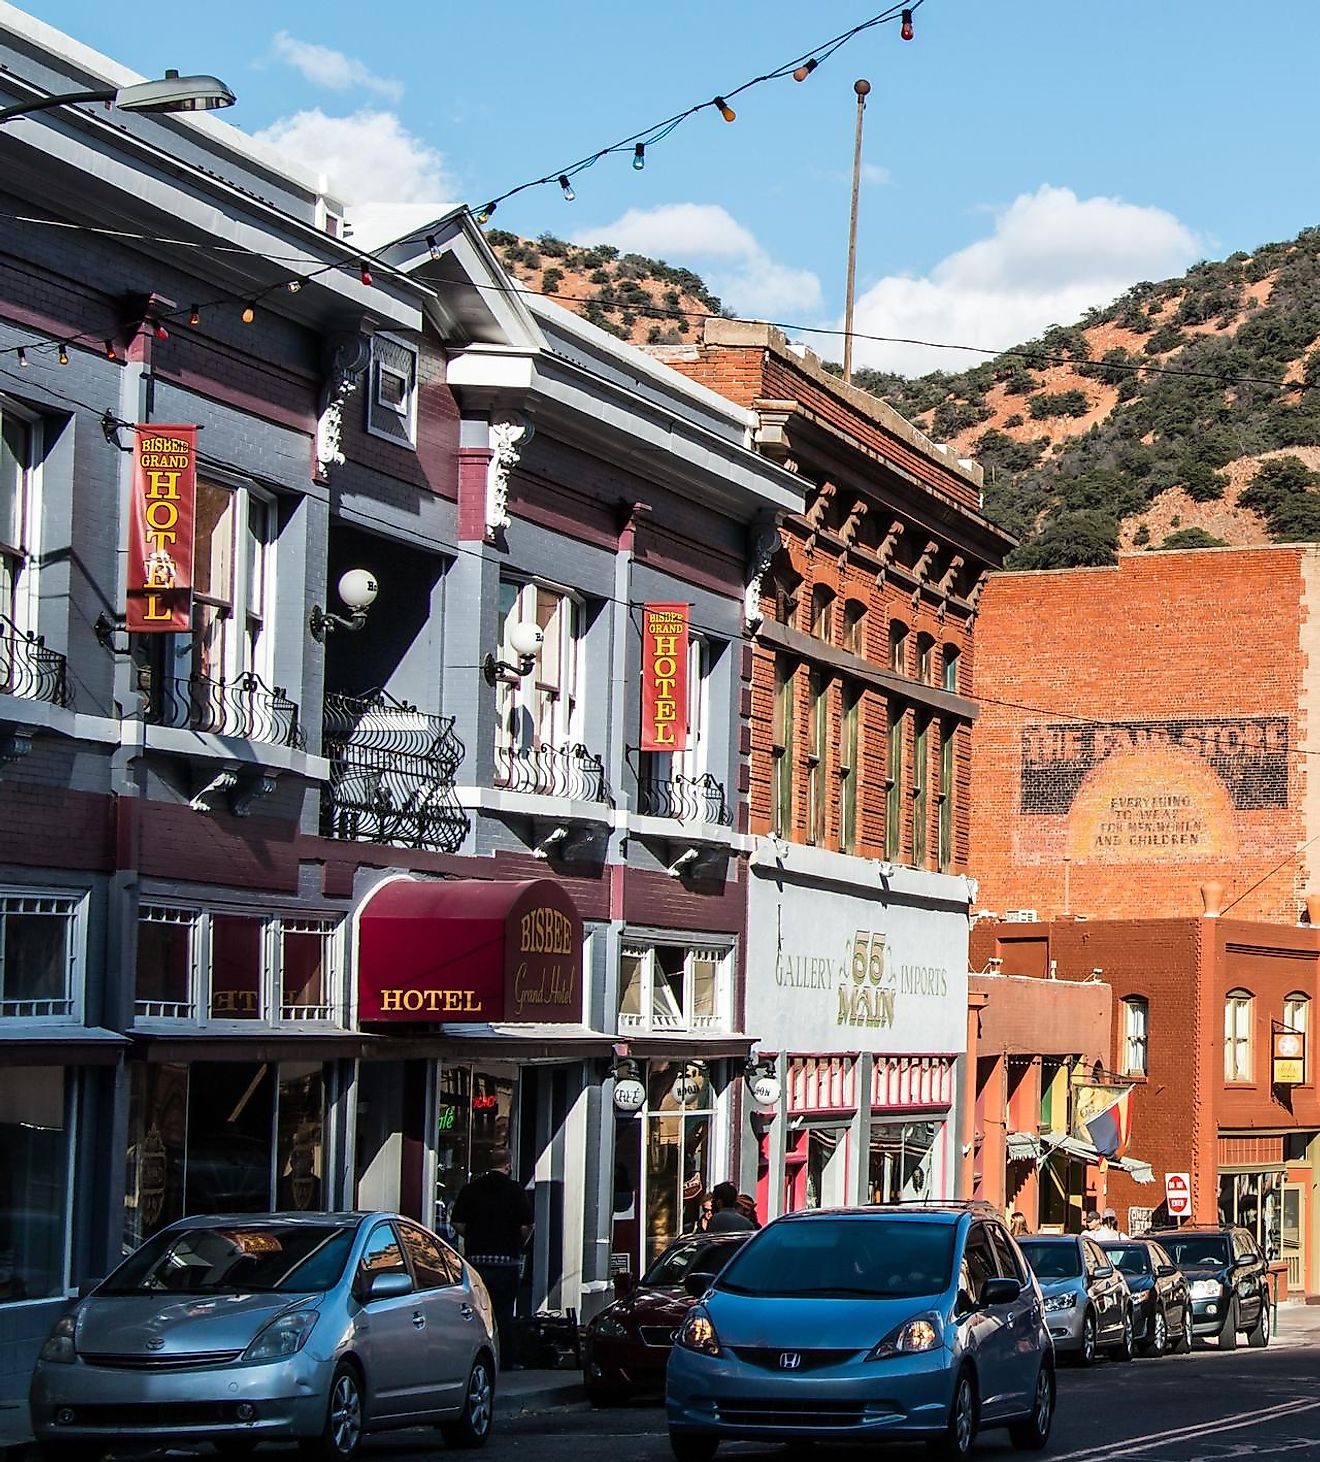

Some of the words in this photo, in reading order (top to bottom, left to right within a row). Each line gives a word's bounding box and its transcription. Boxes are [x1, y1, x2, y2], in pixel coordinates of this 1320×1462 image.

[140, 454, 189, 469] GRAND
[141, 437, 189, 453] BISBEE
[143, 471, 182, 620] HOTEL
[649, 624, 683, 634] GRAND
[653, 636, 678, 743] HOTEL
[1096, 835, 1120, 846] AND
[1129, 834, 1199, 845] CHILDREN
[520, 907, 572, 954] BISBEE
[776, 952, 836, 990] GALLERY
[852, 929, 886, 986] 55
[513, 962, 547, 1015] Grand
[544, 965, 575, 1005] Hotel
[901, 965, 948, 997] IMPORTS
[380, 989, 482, 1012] HOTEL
[837, 983, 896, 1029] MAIN
[614, 1086, 641, 1104] CAFÉ
